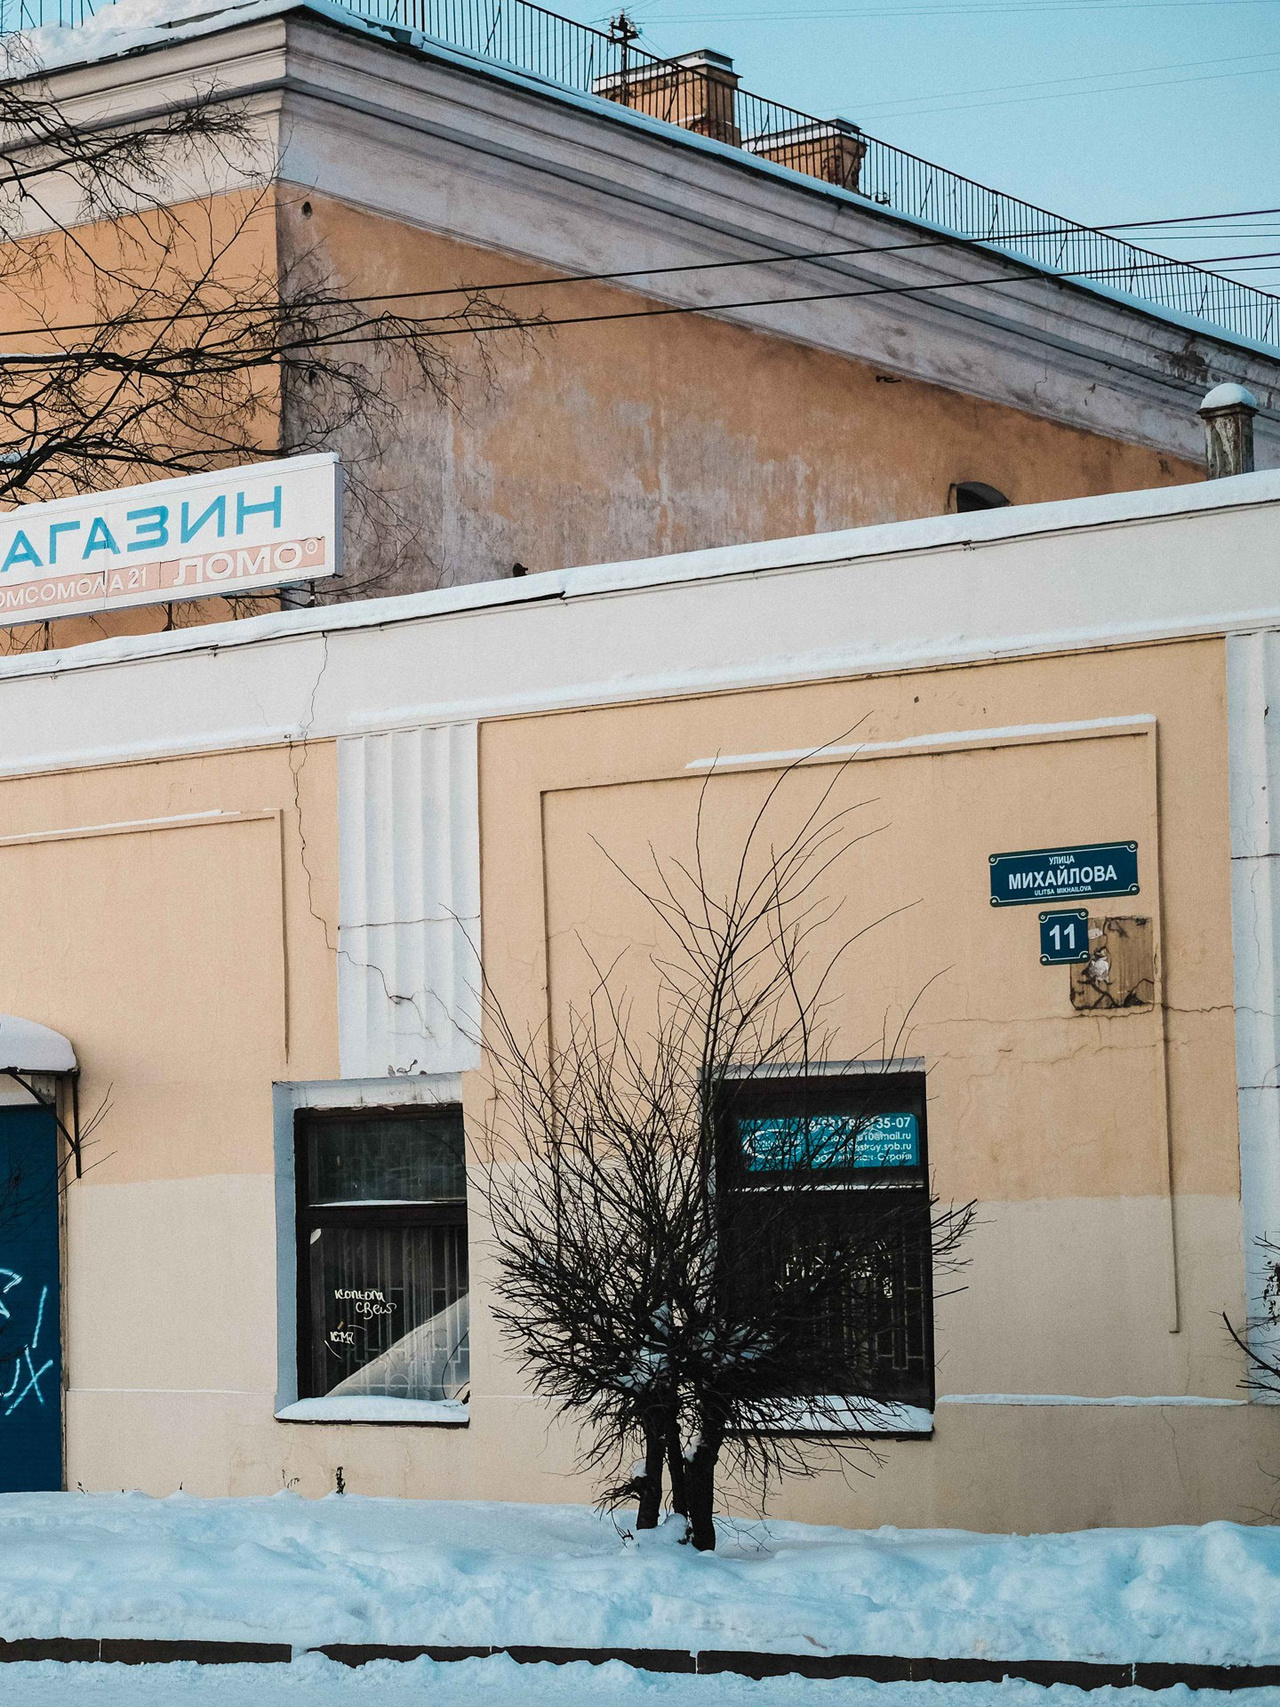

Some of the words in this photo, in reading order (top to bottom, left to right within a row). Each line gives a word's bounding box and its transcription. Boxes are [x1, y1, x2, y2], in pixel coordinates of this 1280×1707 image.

[127, 567, 147, 589] 21
[1049, 855, 1075, 865] УЛИЦА
[1008, 865, 1117, 890] МИХАЙЛОВА
[1056, 885, 1092, 894] MIKHAILOVA
[1049, 924, 1075, 950] 11
